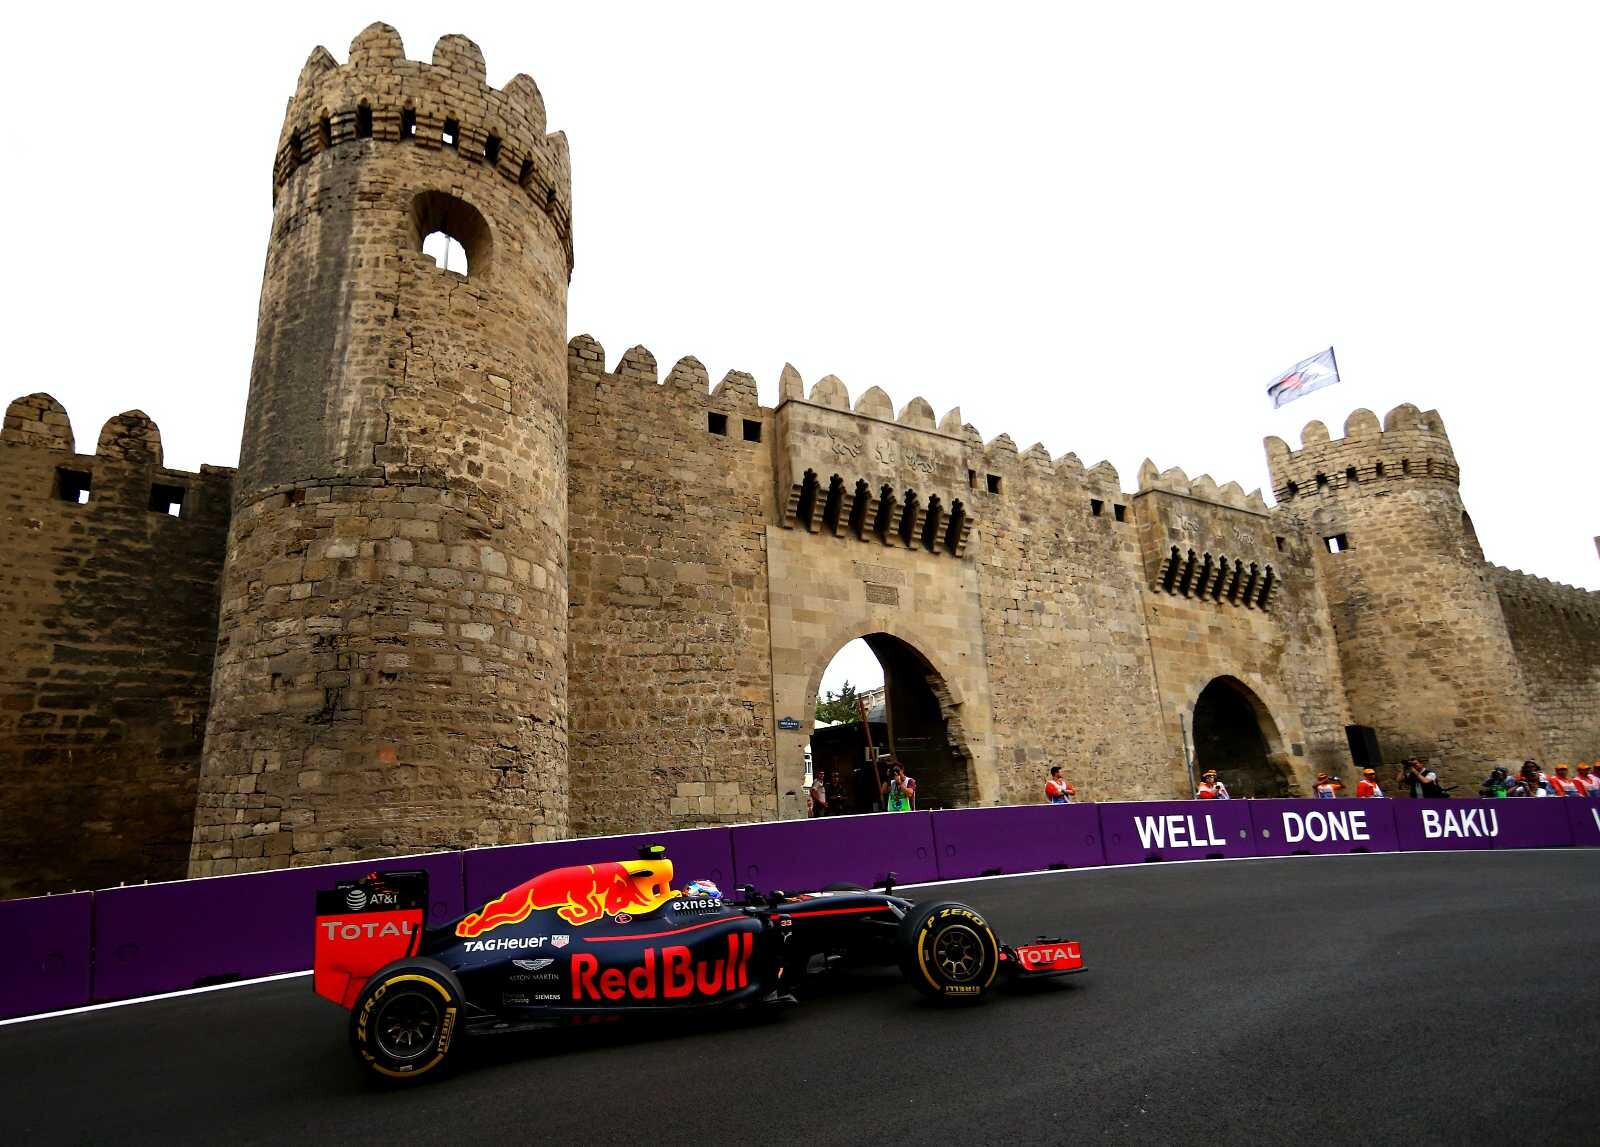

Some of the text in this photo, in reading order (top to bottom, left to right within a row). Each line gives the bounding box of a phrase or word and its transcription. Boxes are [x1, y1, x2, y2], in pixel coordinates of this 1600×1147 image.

[1134, 808, 1499, 849] WELL DONE BAKU
[673, 898, 721, 911] exness
[780, 919, 792, 927] 33
[927, 908, 985, 928] P ZERO
[321, 921, 418, 941] TOTAL
[1018, 948, 1081, 963] TOTAL
[357, 985, 387, 1042] ZERO
